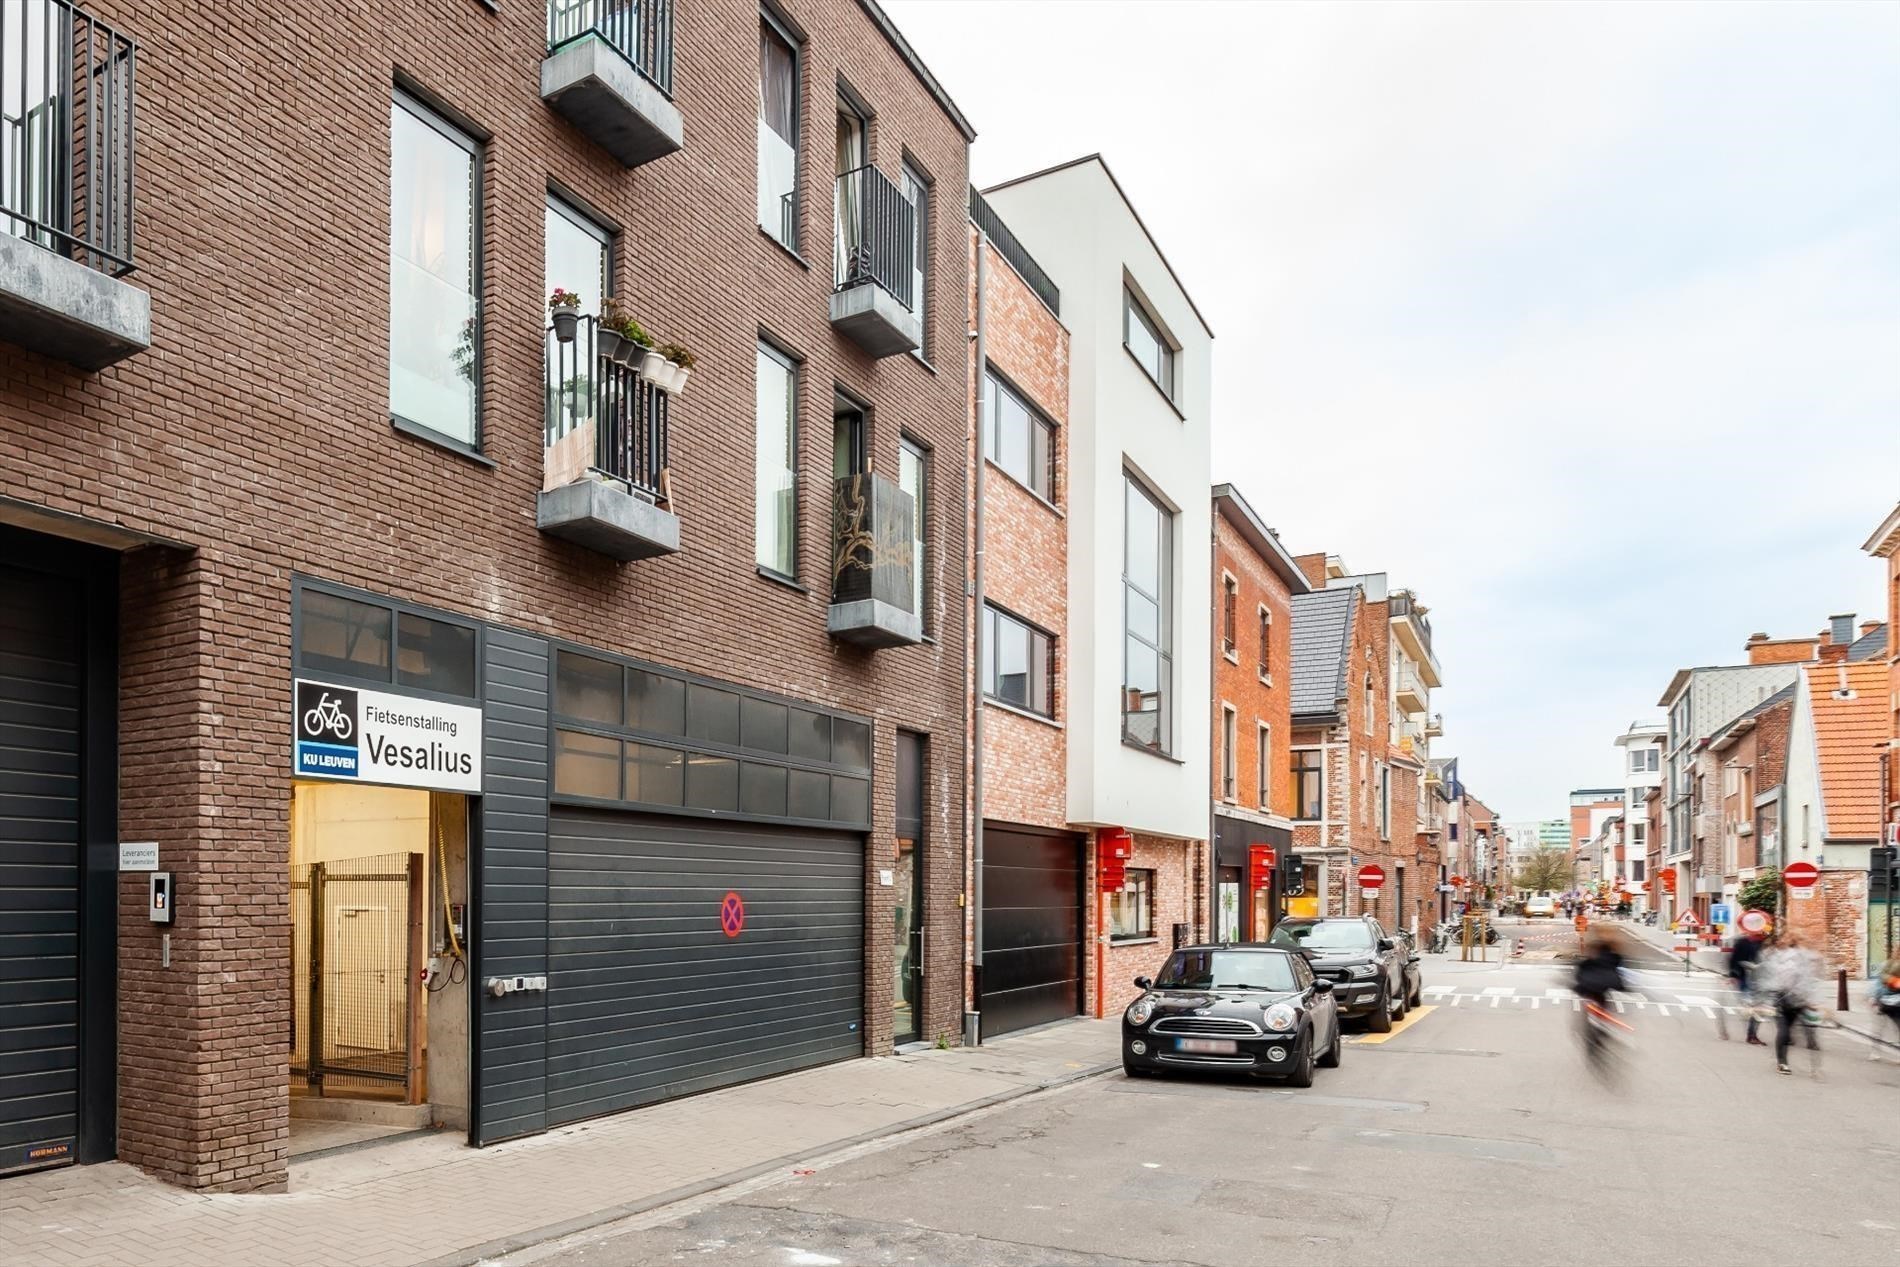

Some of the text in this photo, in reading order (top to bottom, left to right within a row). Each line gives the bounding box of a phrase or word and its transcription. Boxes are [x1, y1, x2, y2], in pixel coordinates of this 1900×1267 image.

[366, 706, 457, 737] Fietsenstalling
[303, 753, 355, 769] KU LEUVEN
[366, 733, 472, 774] Vesalius
[122, 849, 156, 857] Leveranciers
